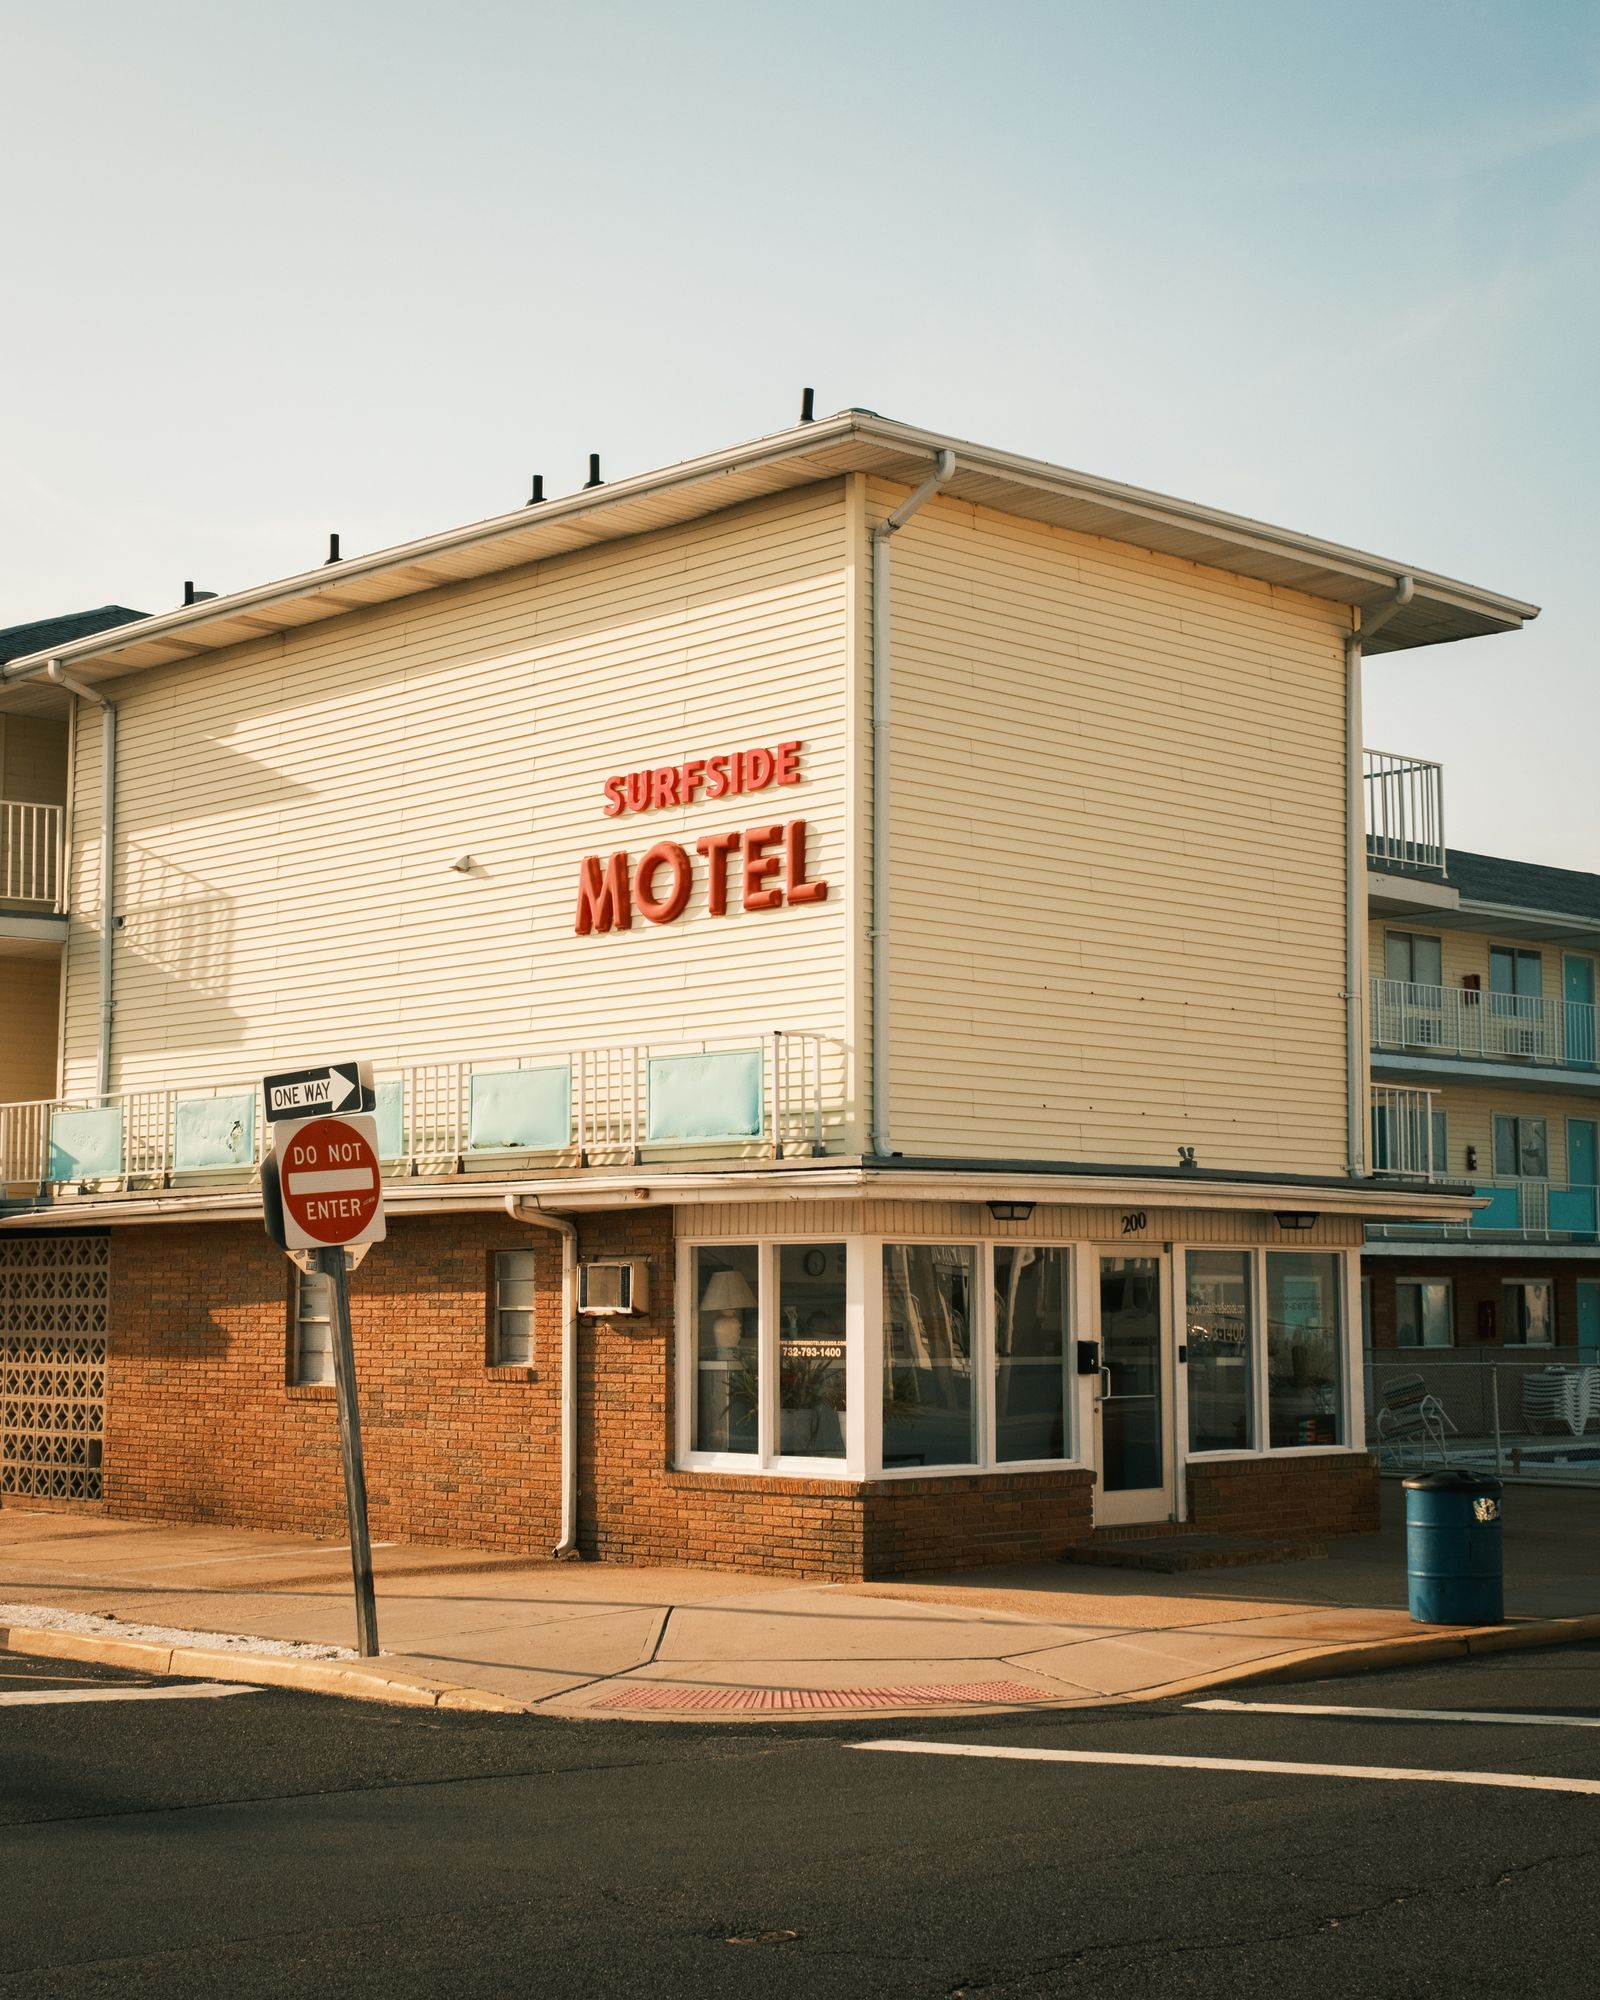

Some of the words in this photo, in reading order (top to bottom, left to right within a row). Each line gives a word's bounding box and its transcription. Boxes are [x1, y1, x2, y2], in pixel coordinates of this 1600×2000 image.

[603, 740, 801, 817] SURFSIDE
[574, 818, 828, 936] MOTEL
[274, 1086, 300, 1108] ONE
[304, 1081, 331, 1103] WAY
[293, 1145, 317, 1165] DO
[328, 1143, 362, 1163] NOT
[306, 1198, 362, 1221] ENTER
[1121, 1211, 1147, 1234] 200
[782, 1347, 841, 1357] 732-793-1400
